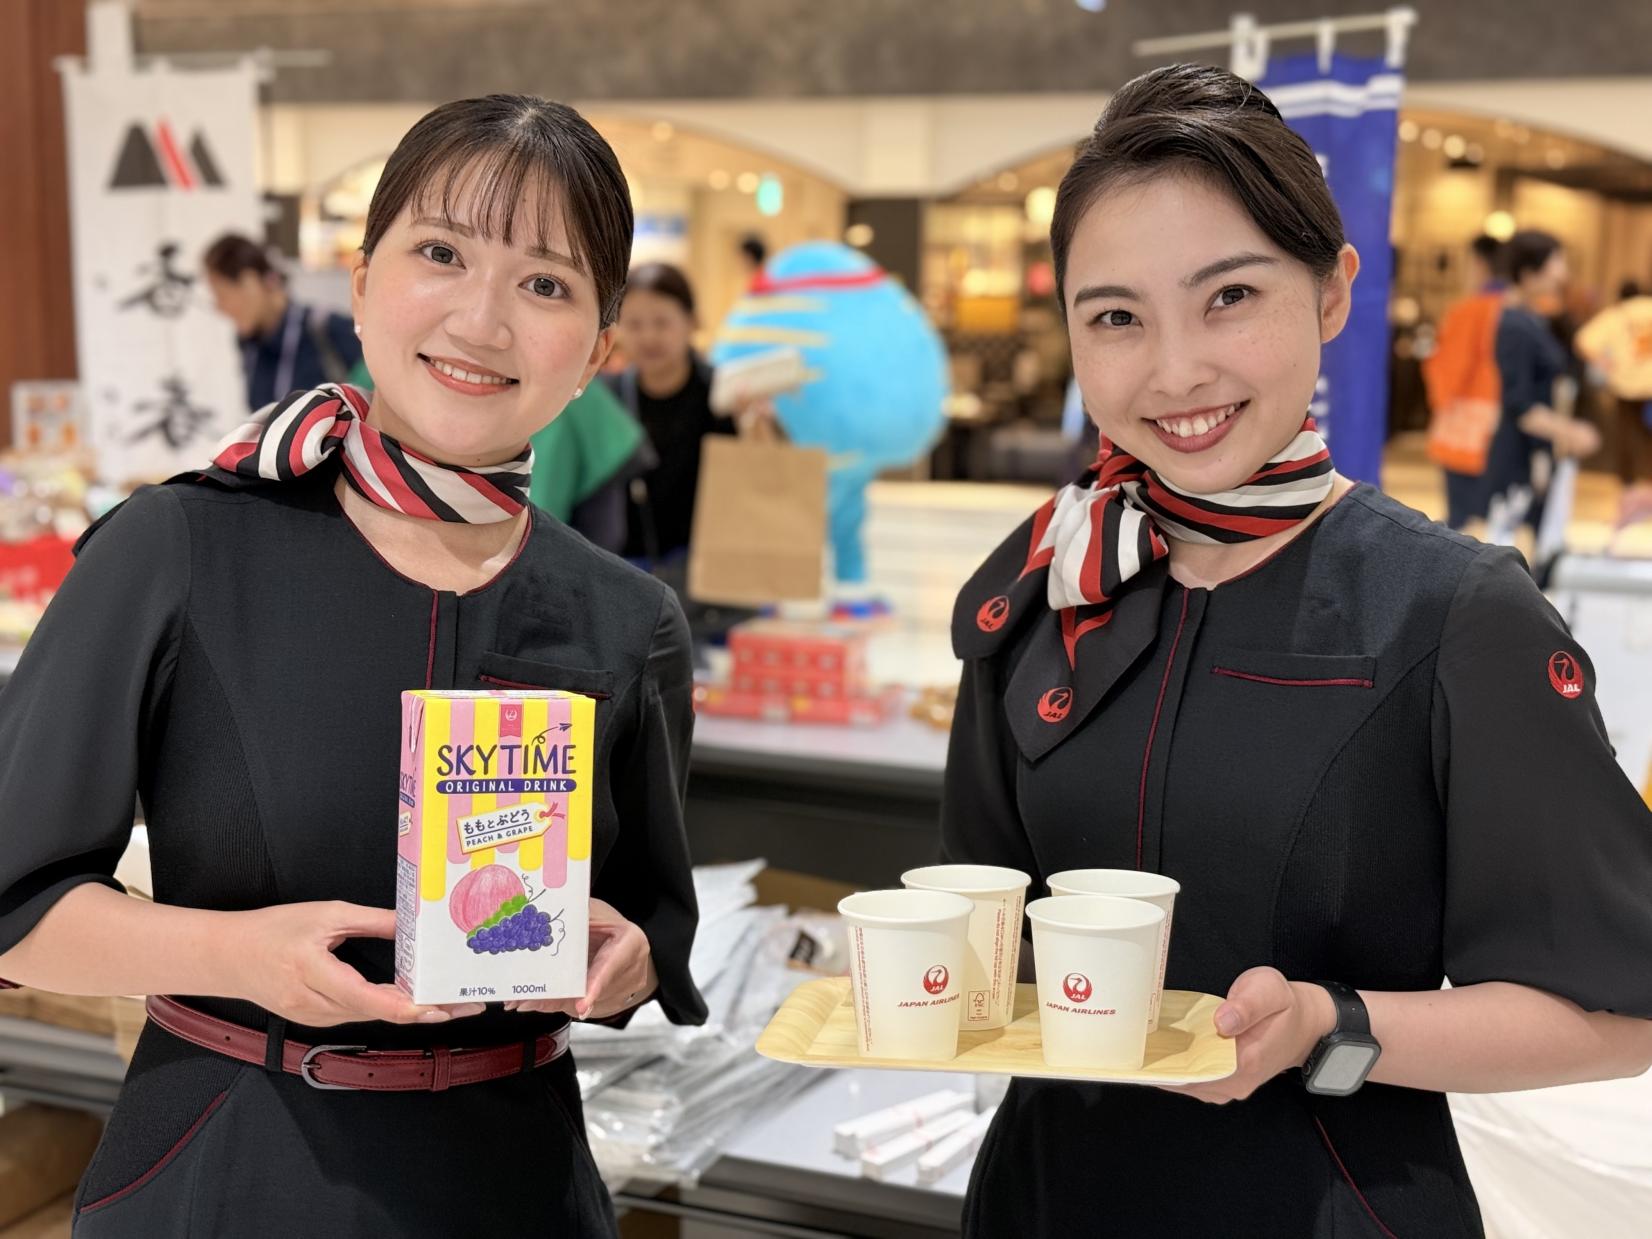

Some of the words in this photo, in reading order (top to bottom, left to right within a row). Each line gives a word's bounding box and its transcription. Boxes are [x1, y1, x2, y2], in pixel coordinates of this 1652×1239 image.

[1562, 683, 1581, 694] JAL
[1044, 711, 1063, 719] JAL
[436, 744, 577, 776] SKYTIME
[445, 781, 514, 793] ORIGINAL
[523, 780, 567, 791] DRINK
[463, 808, 530, 835] ももとぶどう
[466, 834, 494, 847] PEACH
[505, 825, 533, 837] GRAPE
[459, 986, 496, 996] 果汁10%
[512, 983, 546, 994] 1000ml
[1046, 1002, 1070, 1012] JAPAN
